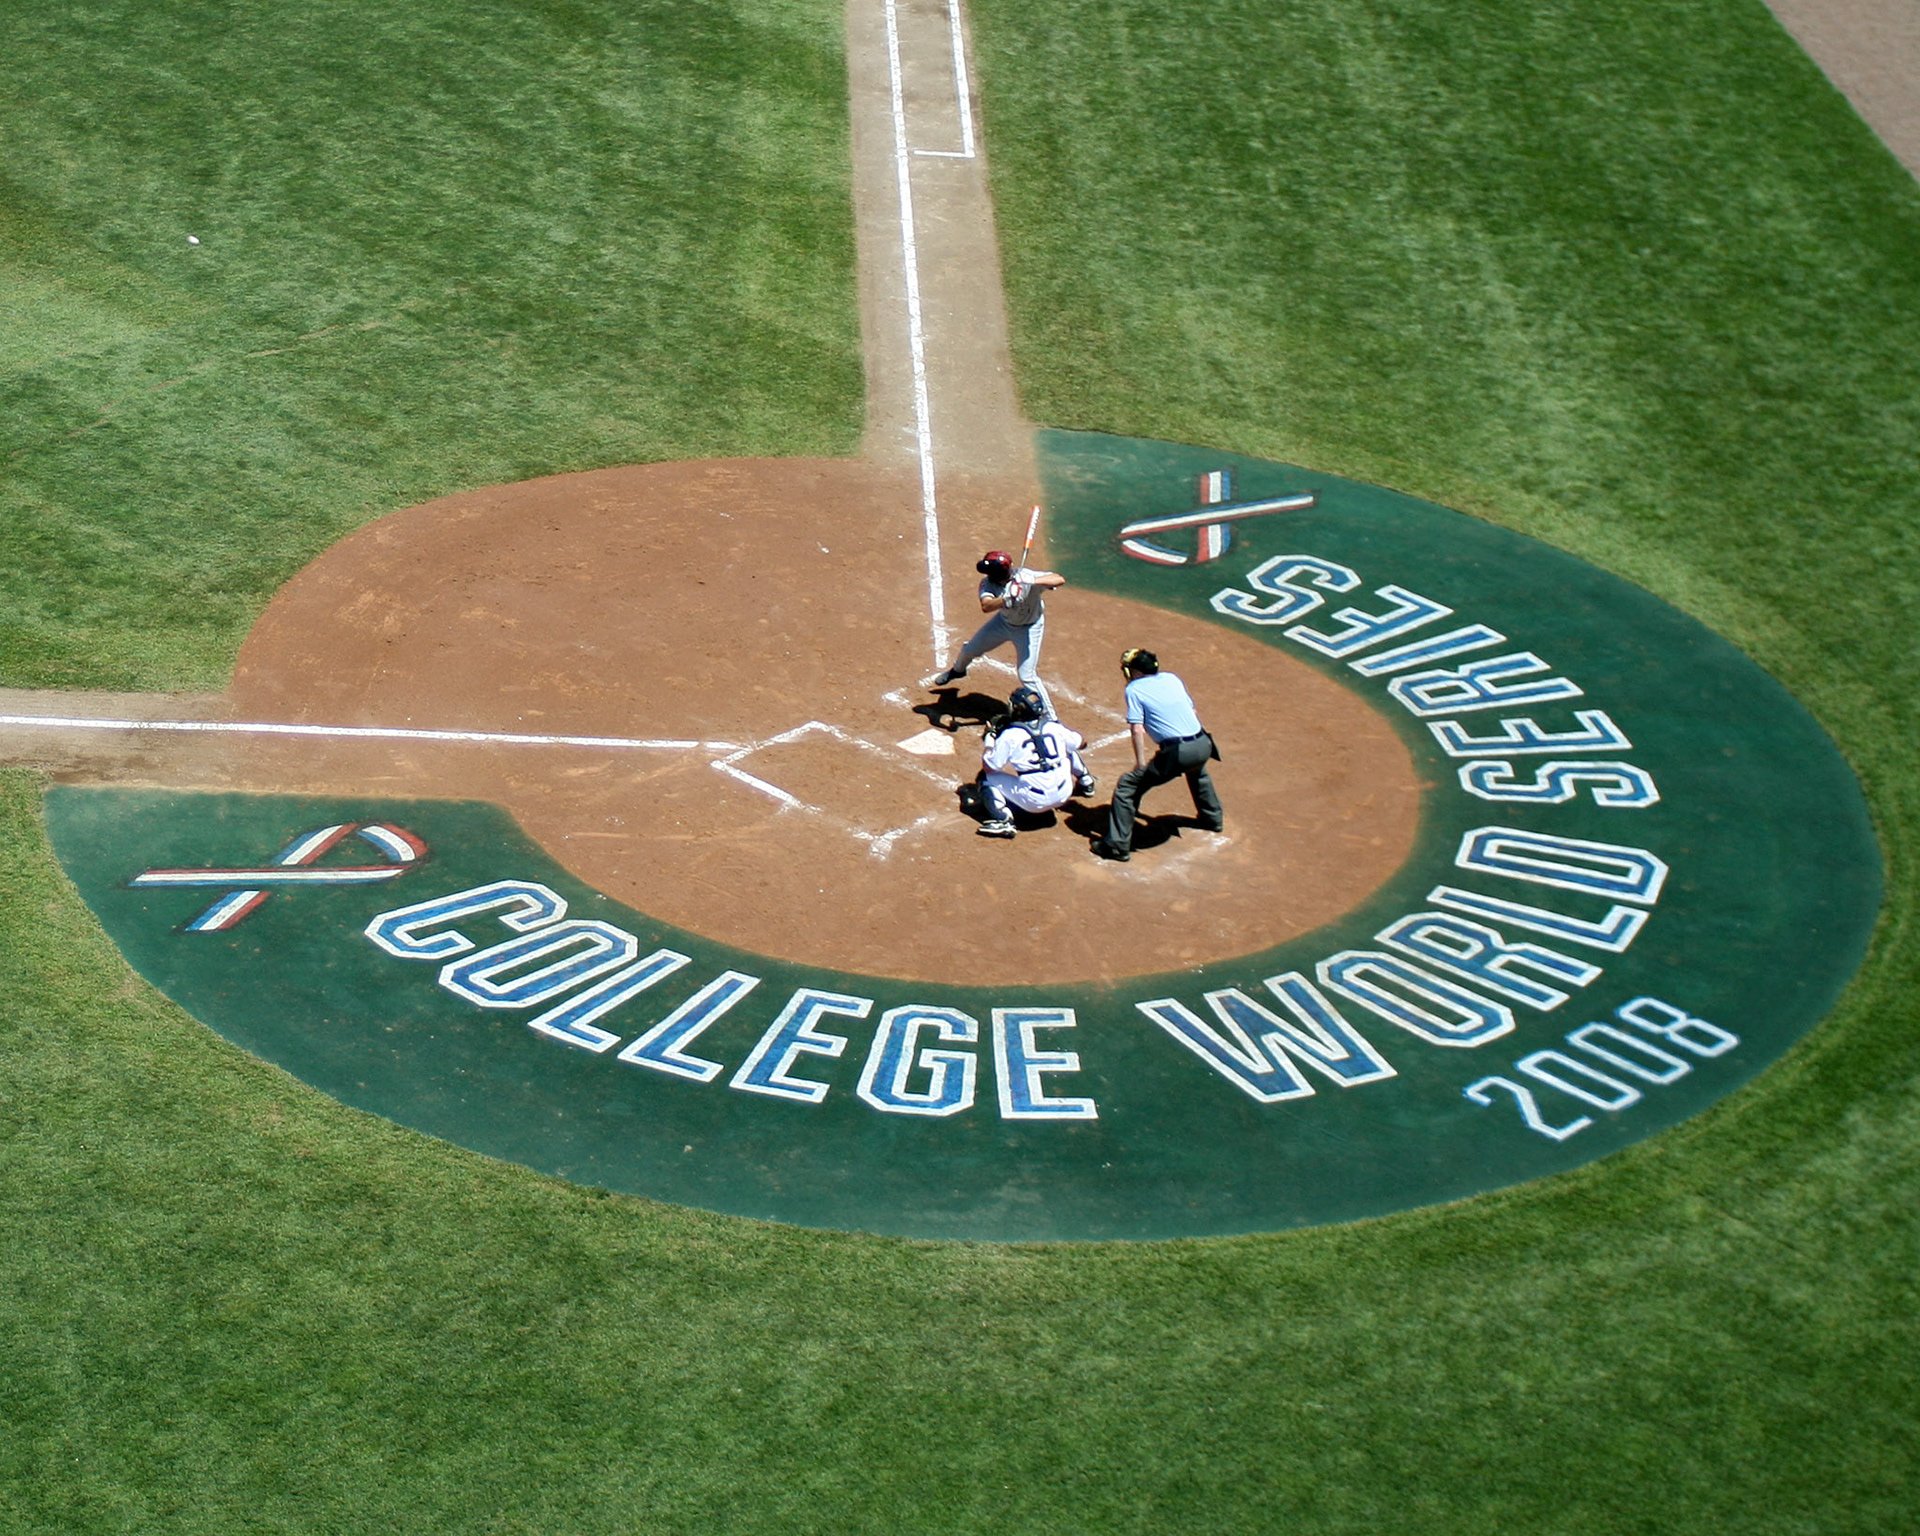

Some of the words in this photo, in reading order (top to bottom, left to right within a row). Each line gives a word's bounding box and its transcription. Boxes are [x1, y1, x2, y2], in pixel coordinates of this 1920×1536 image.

[1021, 733, 1060, 765] 30
[1209, 554, 1661, 809] SERIES
[363, 879, 1099, 1120] COLLEGE
[1135, 825, 1669, 1103] WORLD
[1463, 997, 1739, 1141] 2008
